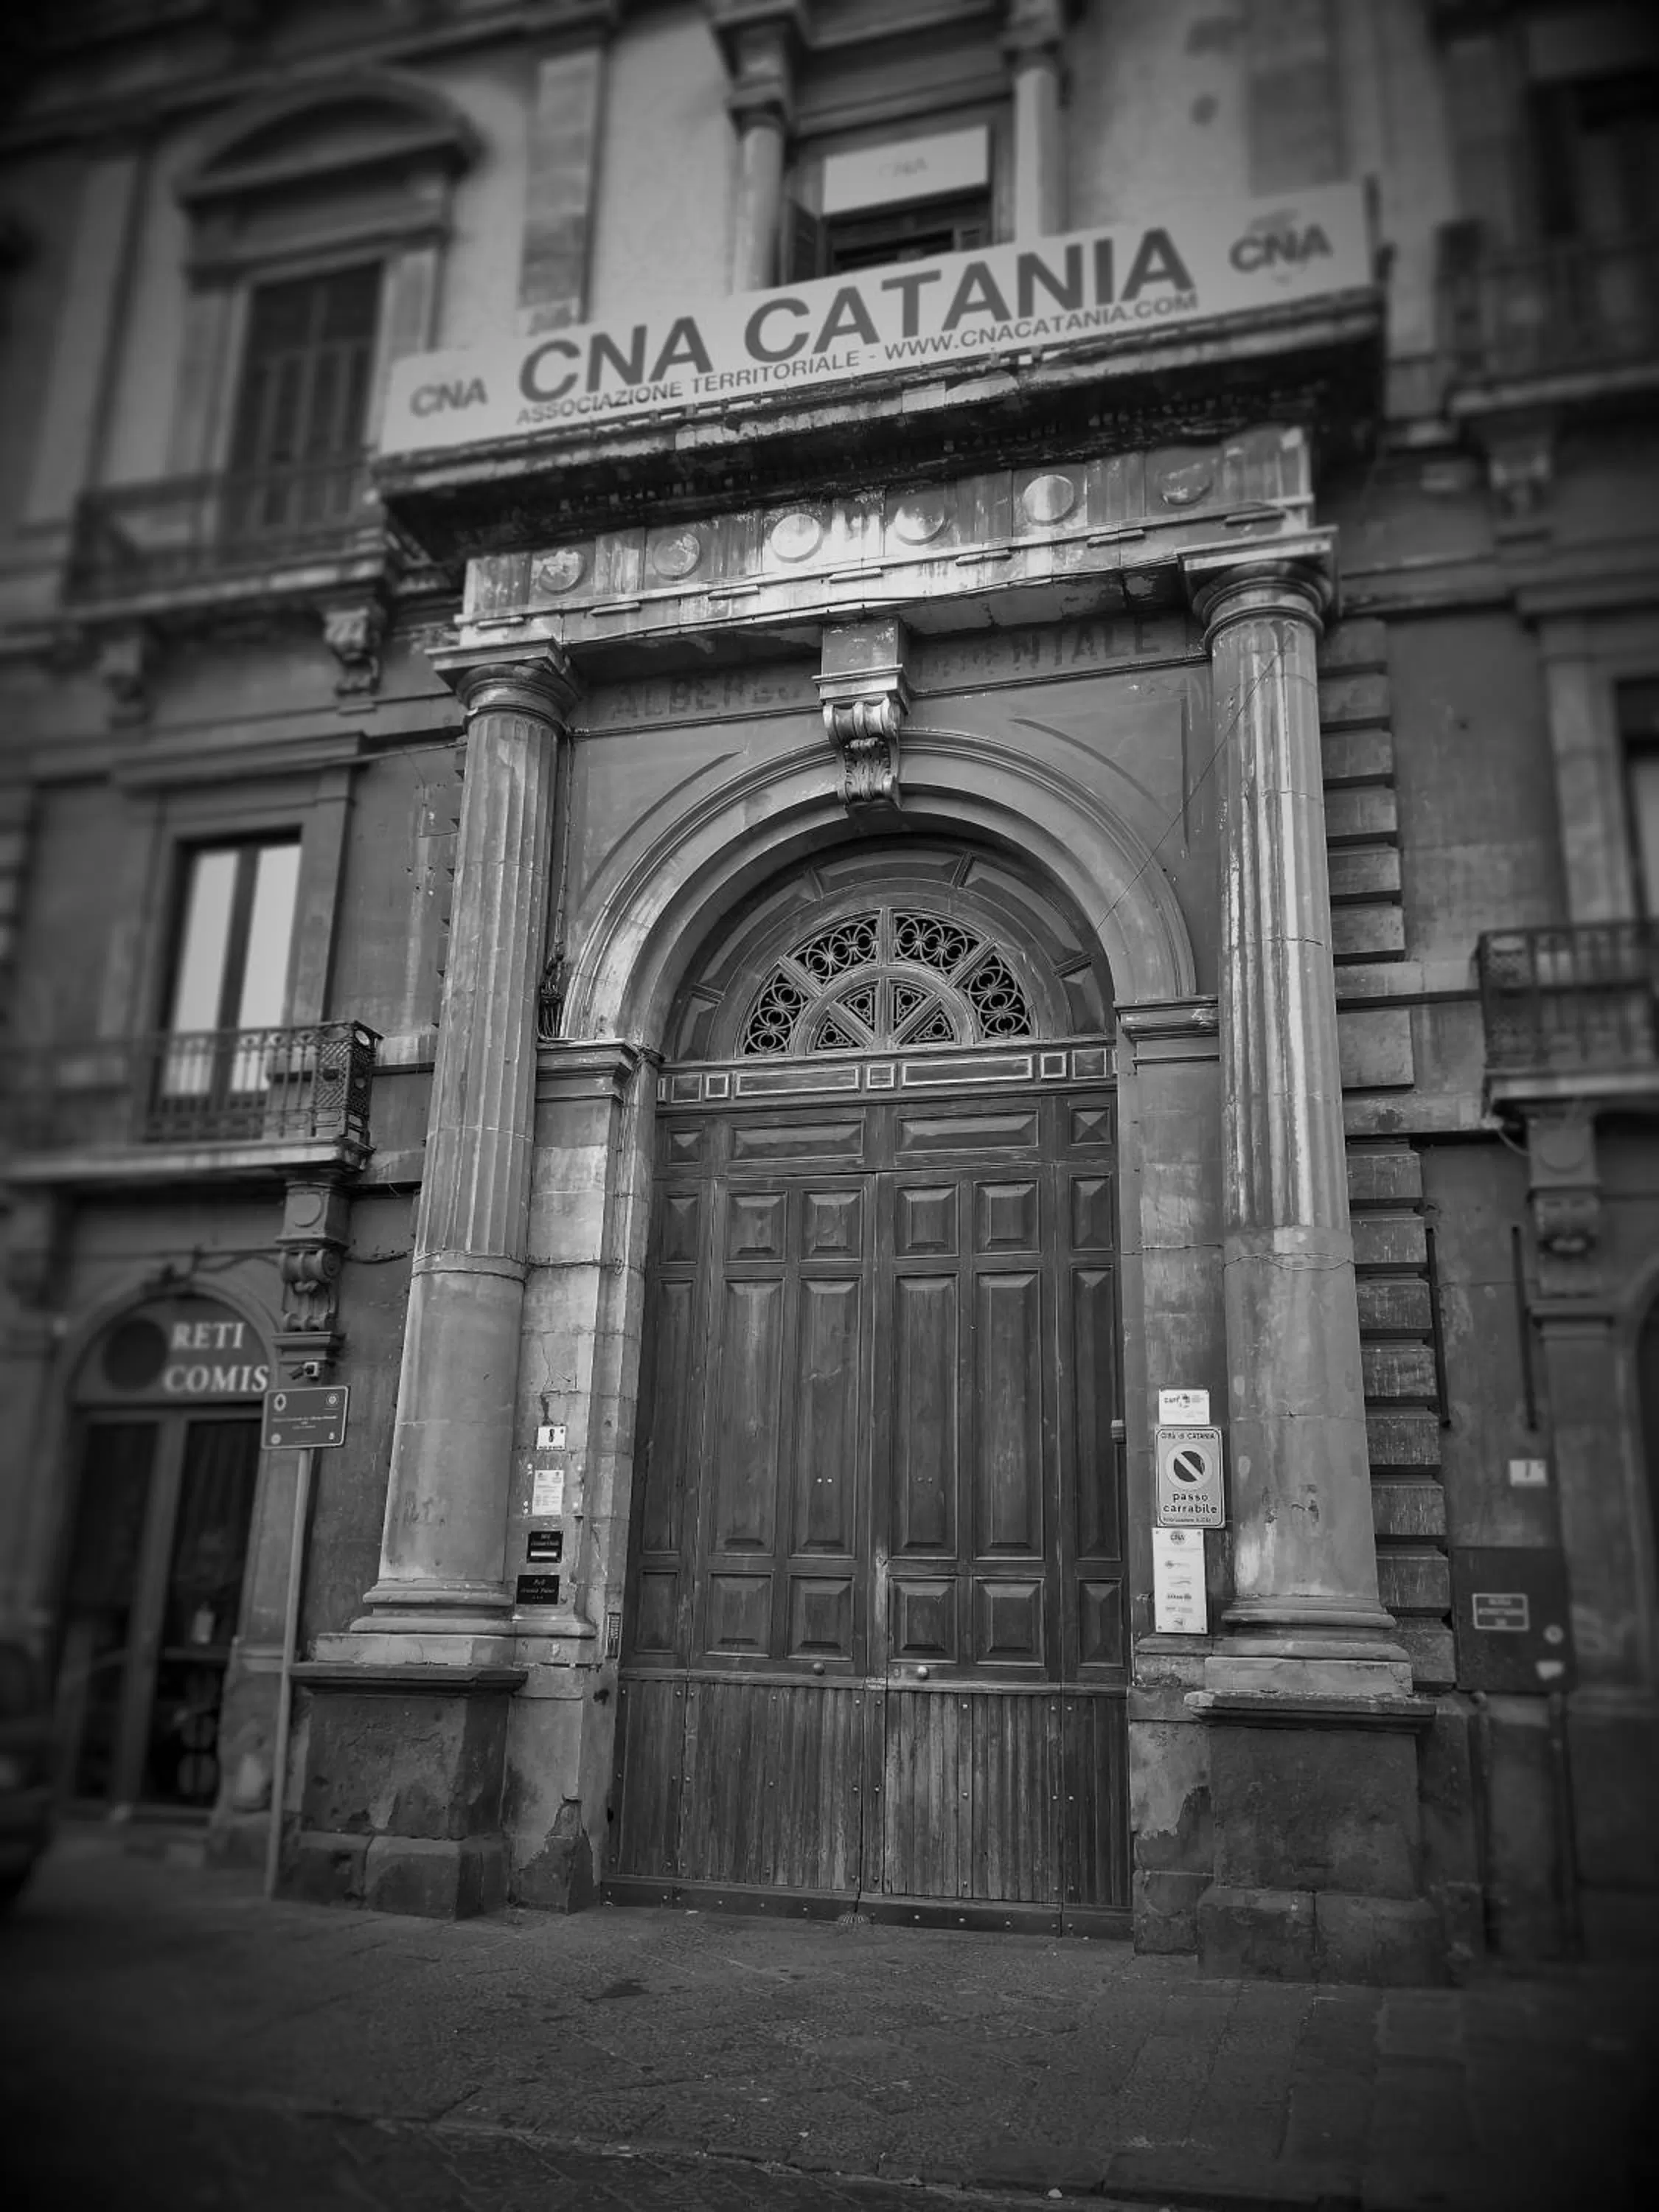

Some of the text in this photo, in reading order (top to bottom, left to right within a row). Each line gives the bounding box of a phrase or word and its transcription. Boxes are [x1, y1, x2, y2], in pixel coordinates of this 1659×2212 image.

[1229, 223, 1333, 274] CNA
[520, 226, 1195, 403] CNA CATANIA
[516, 381, 683, 425] ASSOCIAZIONE
[691, 350, 860, 394] TERRITORIALE
[884, 293, 1198, 361] WWW.CNACATANIA.COM
[409, 377, 488, 418] CNA
[171, 1322, 247, 1350] RETI
[163, 1364, 270, 1393] COMIS
[1163, 1503, 1218, 1514] carrabile
[1172, 1493, 1208, 1503] passo
